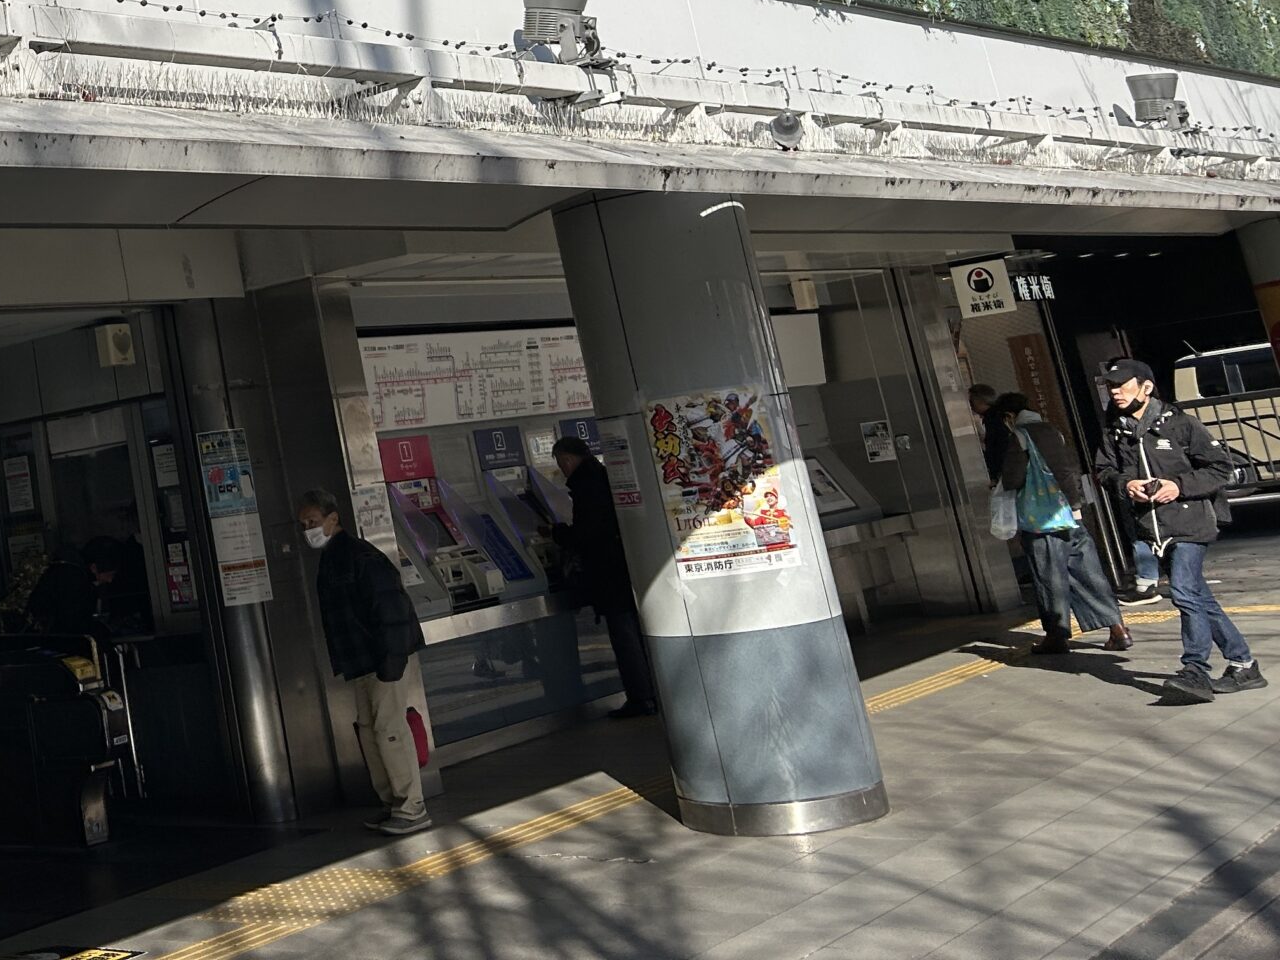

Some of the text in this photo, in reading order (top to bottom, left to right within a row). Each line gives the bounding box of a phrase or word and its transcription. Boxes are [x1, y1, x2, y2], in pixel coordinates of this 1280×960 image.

[684, 558, 734, 573] 東京消防庁
